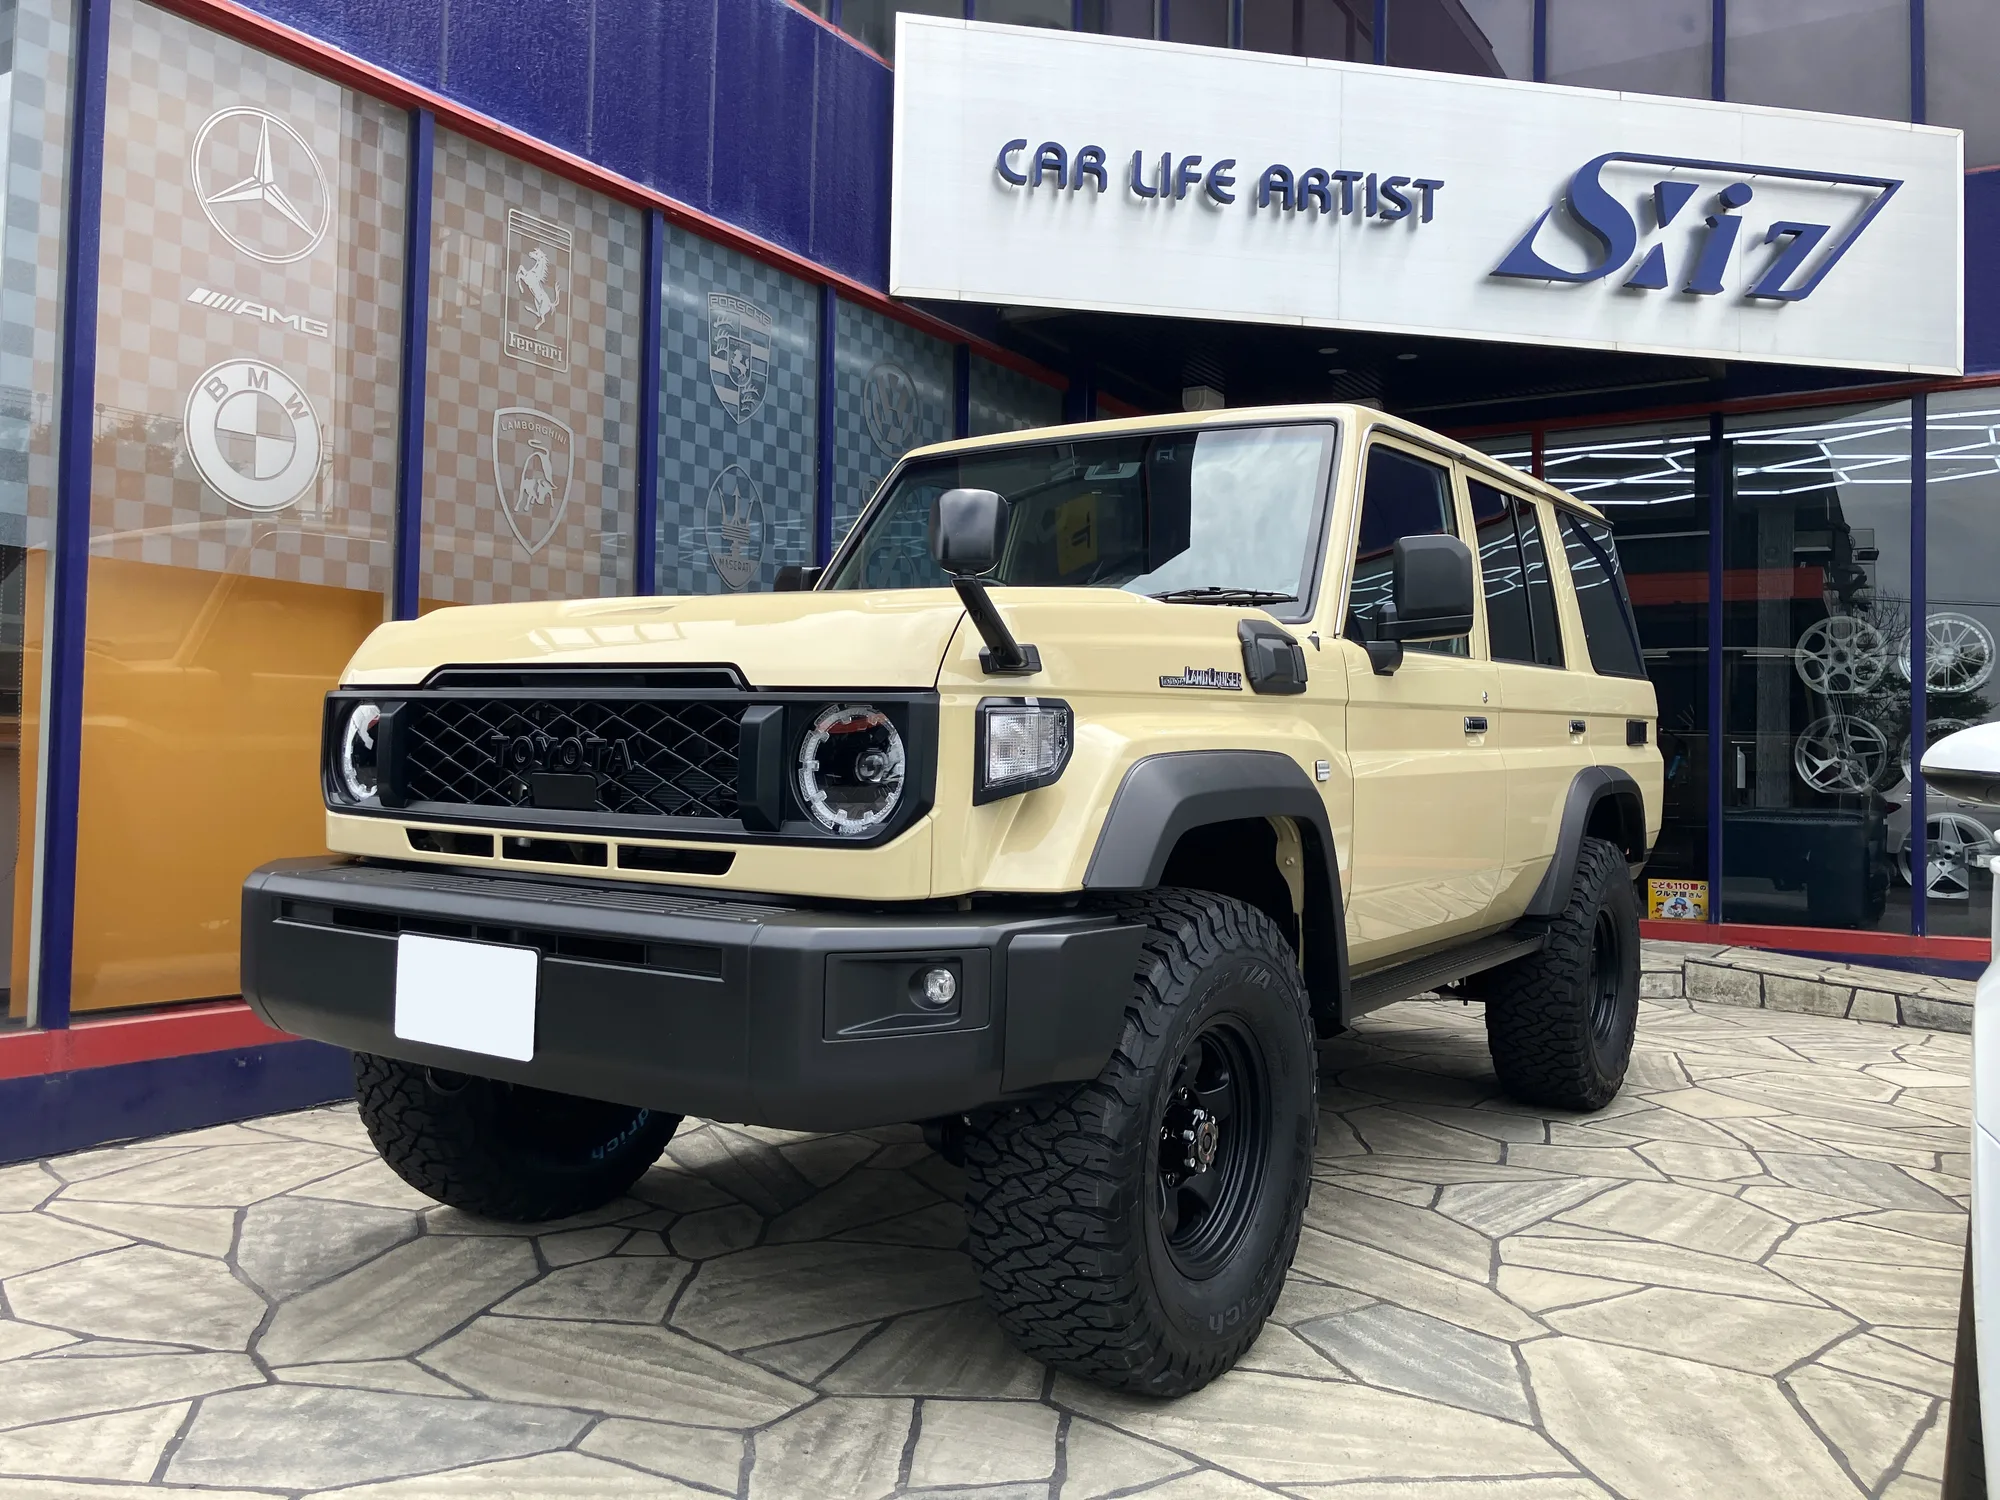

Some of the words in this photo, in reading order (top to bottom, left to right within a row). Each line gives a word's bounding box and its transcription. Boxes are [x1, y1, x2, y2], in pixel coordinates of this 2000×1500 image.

[996, 138, 1108, 194] CAR
[1130, 149, 1236, 205] LIFE
[1258, 163, 1445, 224] ARTIST
[709, 296, 771, 326] PORSCHE
[508, 331, 563, 362] Ferrari
[204, 367, 309, 419] BMW
[501, 420, 567, 445] LAMBORGHINI
[719, 557, 752, 573] MASERATI
[491, 735, 632, 771] TOYOTA
